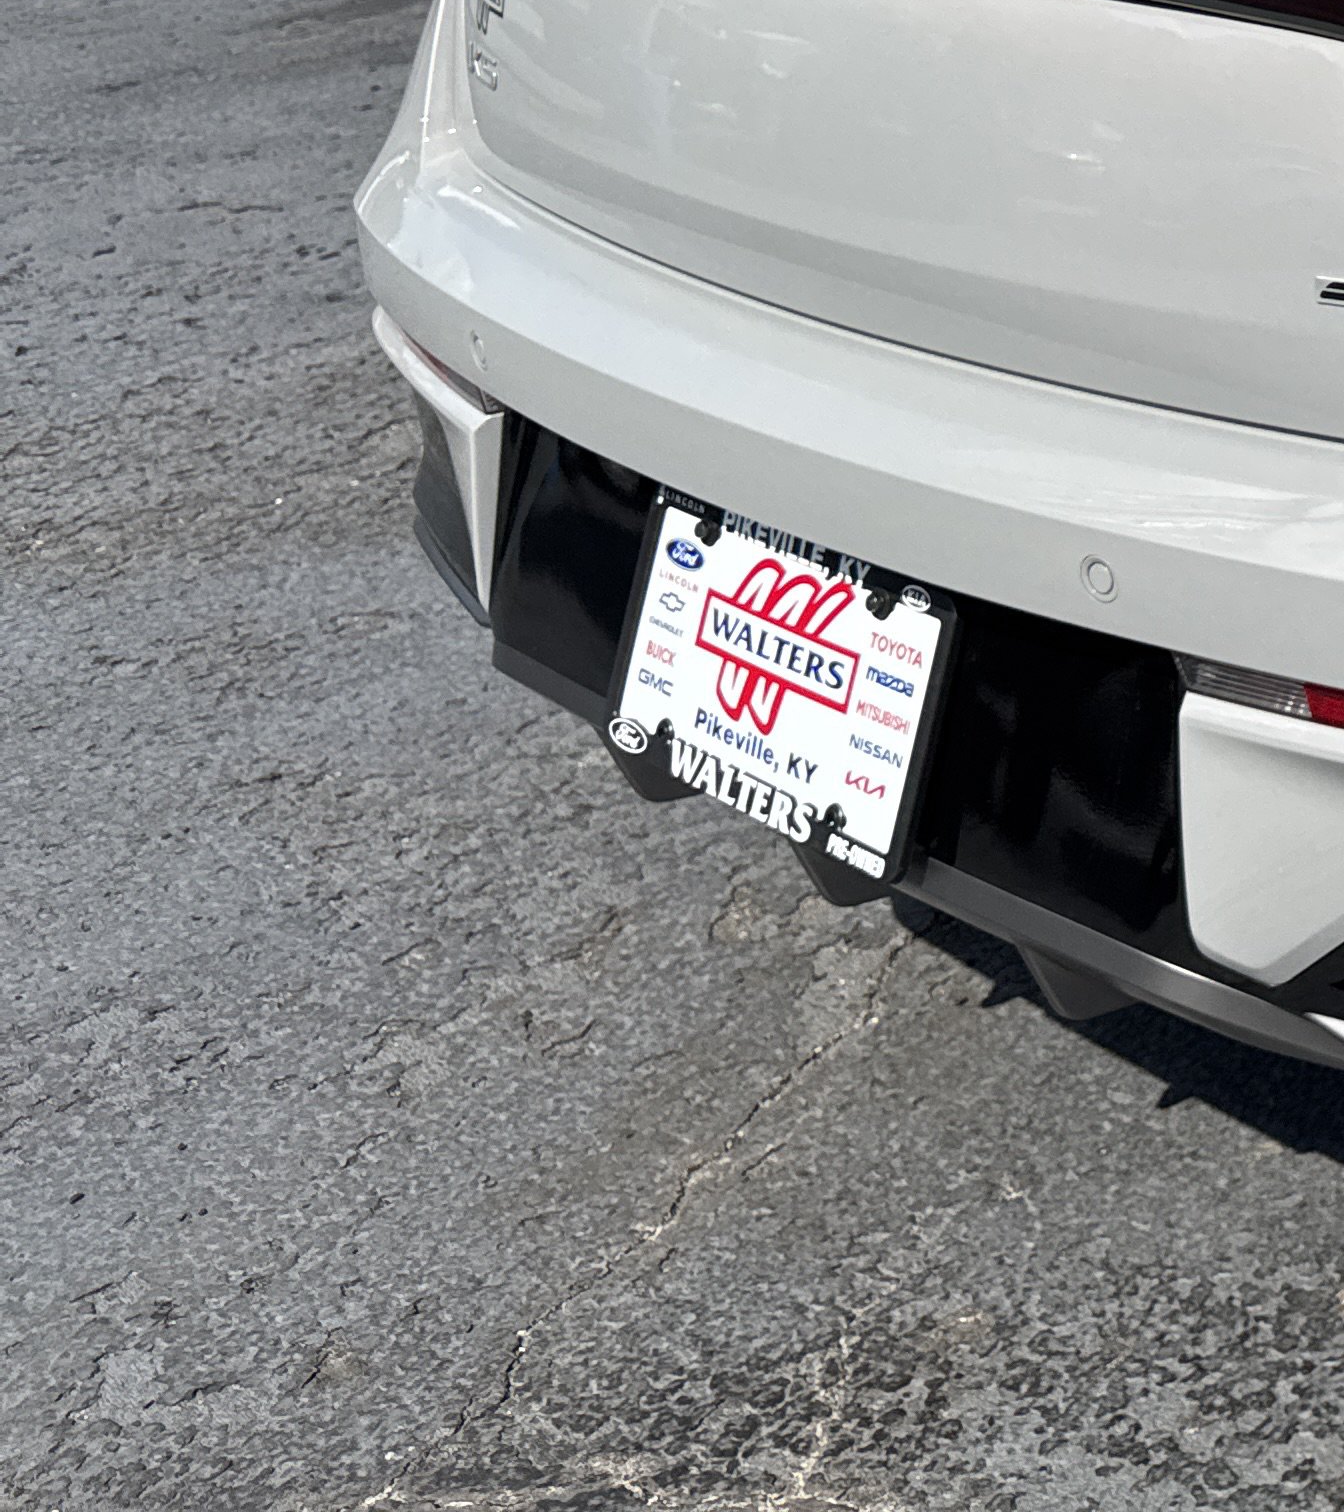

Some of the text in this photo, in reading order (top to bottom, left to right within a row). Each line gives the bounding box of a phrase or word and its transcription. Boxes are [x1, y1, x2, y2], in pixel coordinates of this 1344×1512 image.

[468, 41, 498, 91] K5
[669, 541, 701, 568] Ford
[658, 568, 699, 593] LINCOLN
[649, 616, 684, 638] CHEVROLET
[646, 640, 676, 667] BUICK
[713, 607, 846, 690] WALTERS
[870, 632, 923, 669] TOYOTA
[638, 668, 674, 697] GMC
[856, 699, 910, 735] MITSUBISHI
[694, 707, 819, 784] Pikeville, KY
[849, 734, 904, 769] NISSAN
[671, 738, 814, 843] WALTERS
[845, 770, 887, 800] KIA
